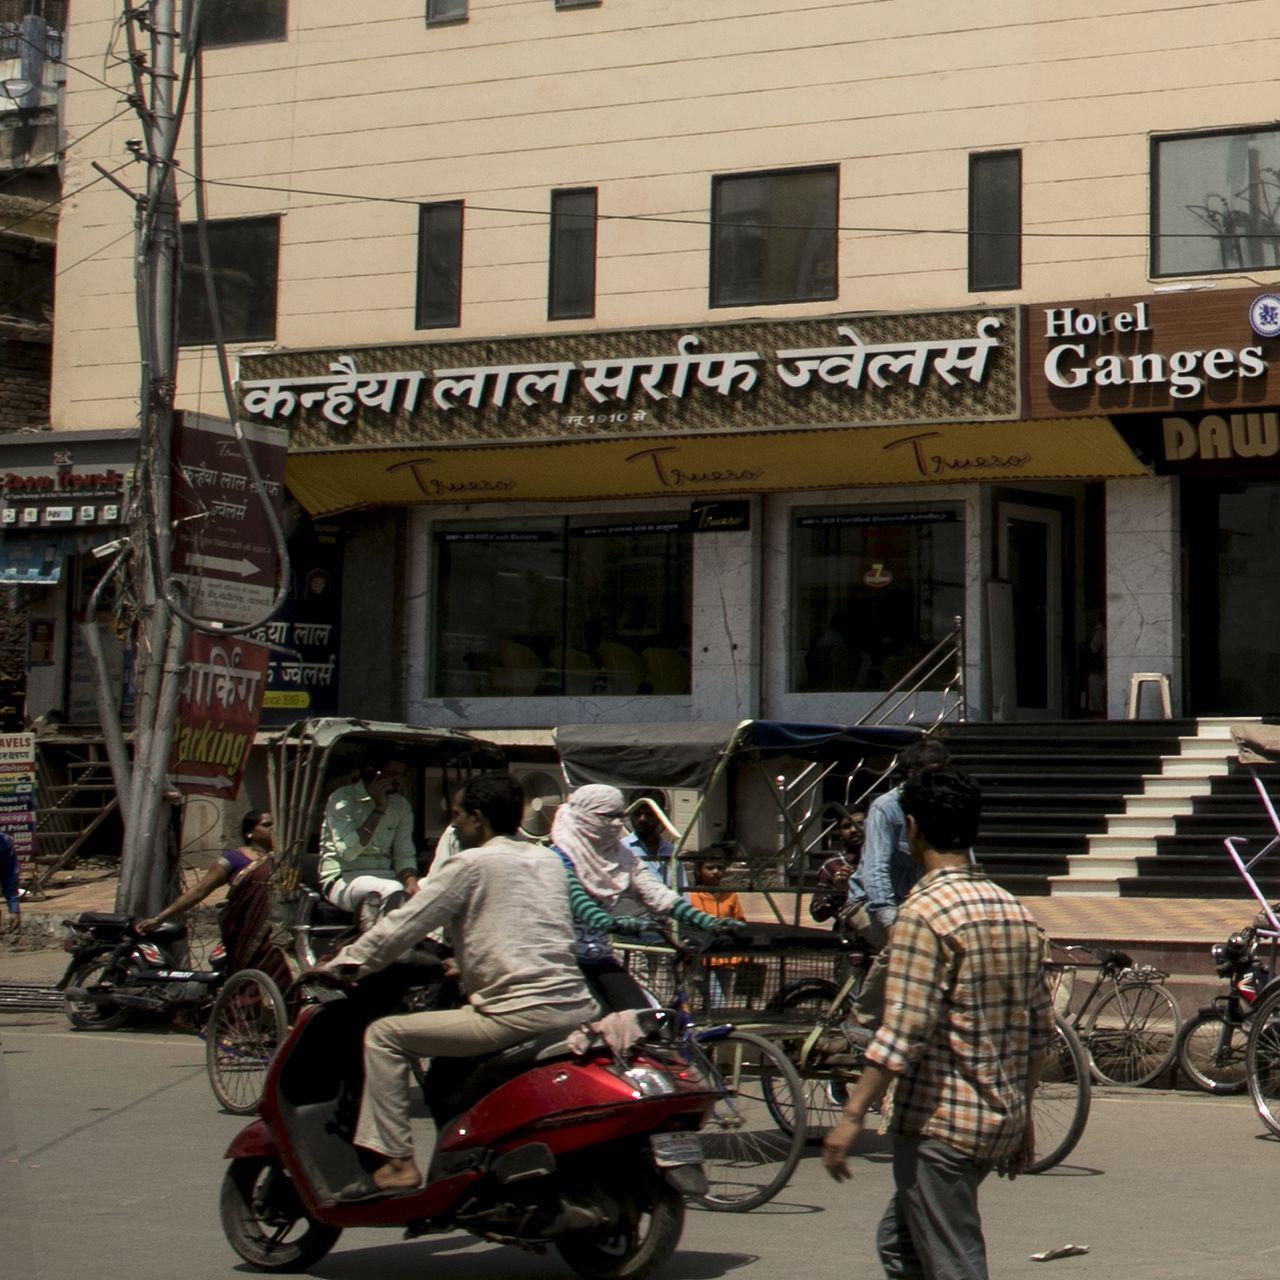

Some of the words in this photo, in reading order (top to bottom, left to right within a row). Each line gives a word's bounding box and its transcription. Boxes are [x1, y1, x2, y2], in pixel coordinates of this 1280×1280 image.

[1043, 302, 1150, 338] Hotel
[240, 355, 428, 425] कन्हैया
[431, 361, 577, 412] लाल
[582, 333, 762, 404] सर्राफ
[775, 316, 1003, 390] ज्वेलर्स
[1043, 343, 1268, 399] Ganges
